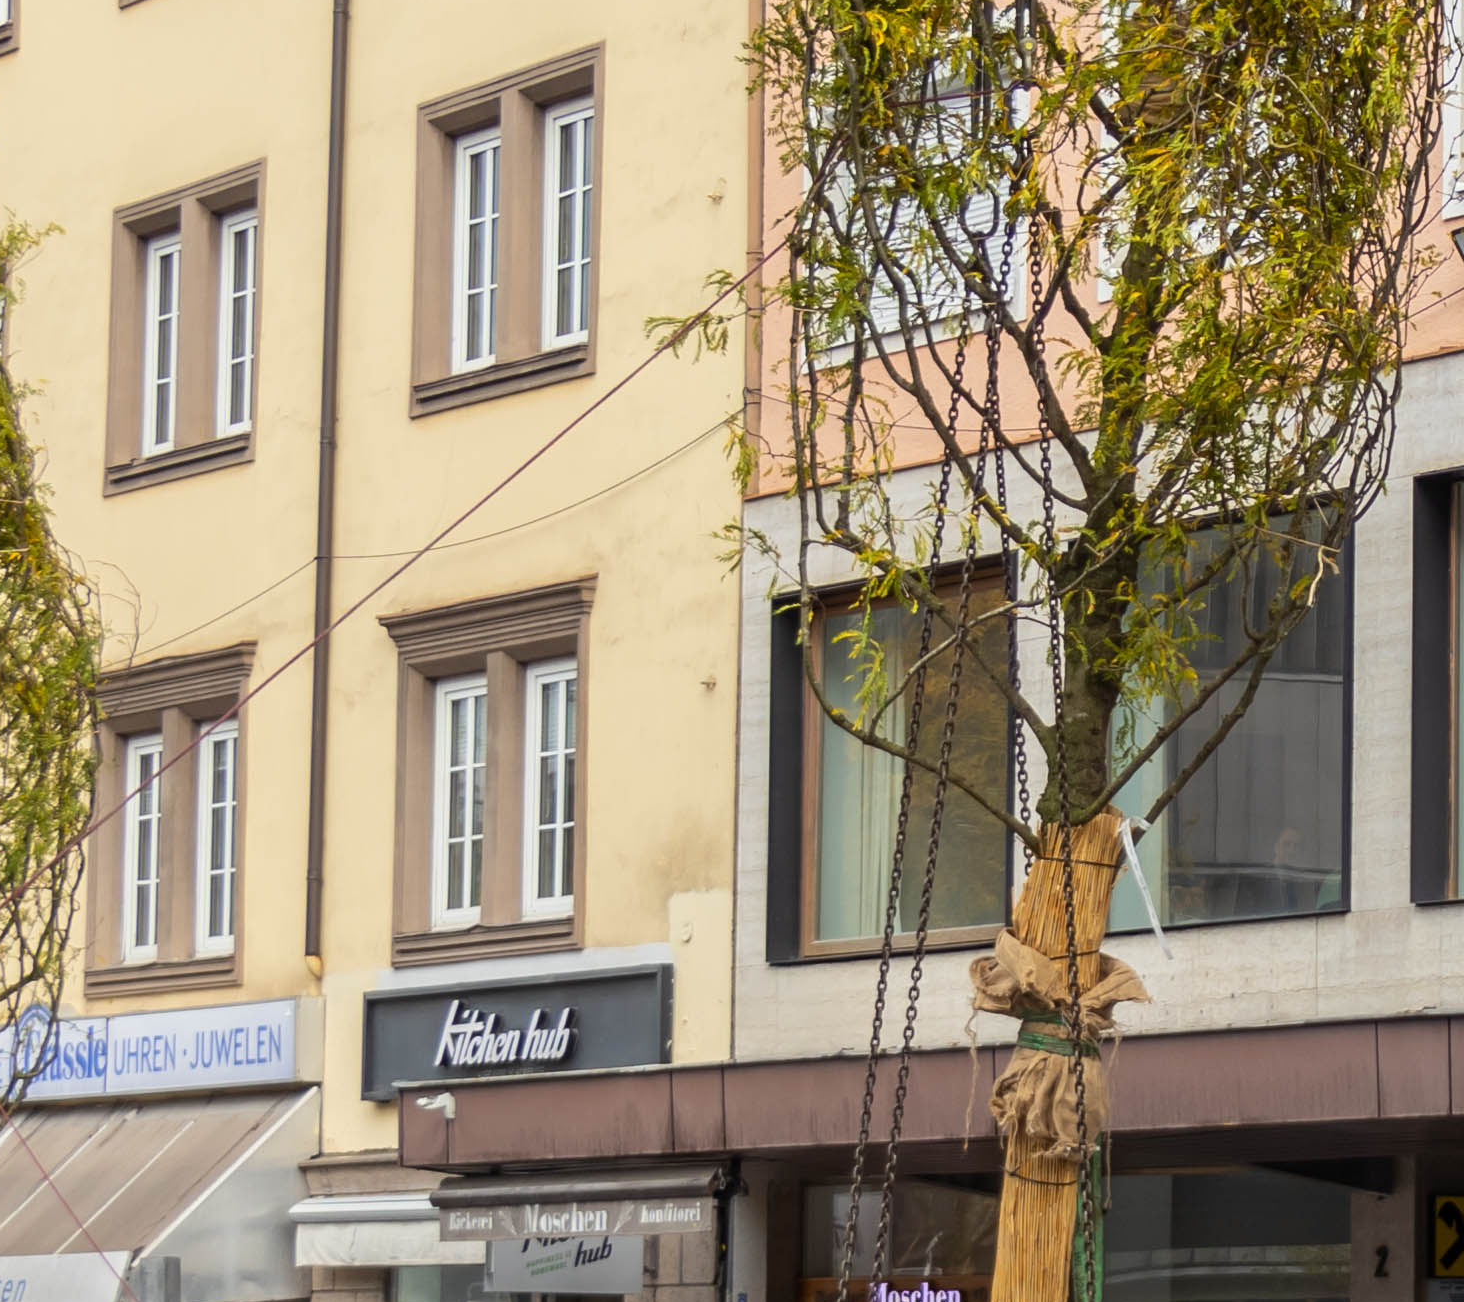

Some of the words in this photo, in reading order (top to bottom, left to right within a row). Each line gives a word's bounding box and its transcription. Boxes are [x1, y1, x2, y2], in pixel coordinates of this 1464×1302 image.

[114, 1033, 177, 1076] UHREN
[190, 1023, 283, 1070] JUWELEN
[522, 1007, 572, 1060] hub
[523, 1202, 609, 1234] Moschen
[640, 1201, 702, 1224] Konditorei
[574, 1235, 613, 1268] hub
[1374, 1245, 1389, 1278] 2
